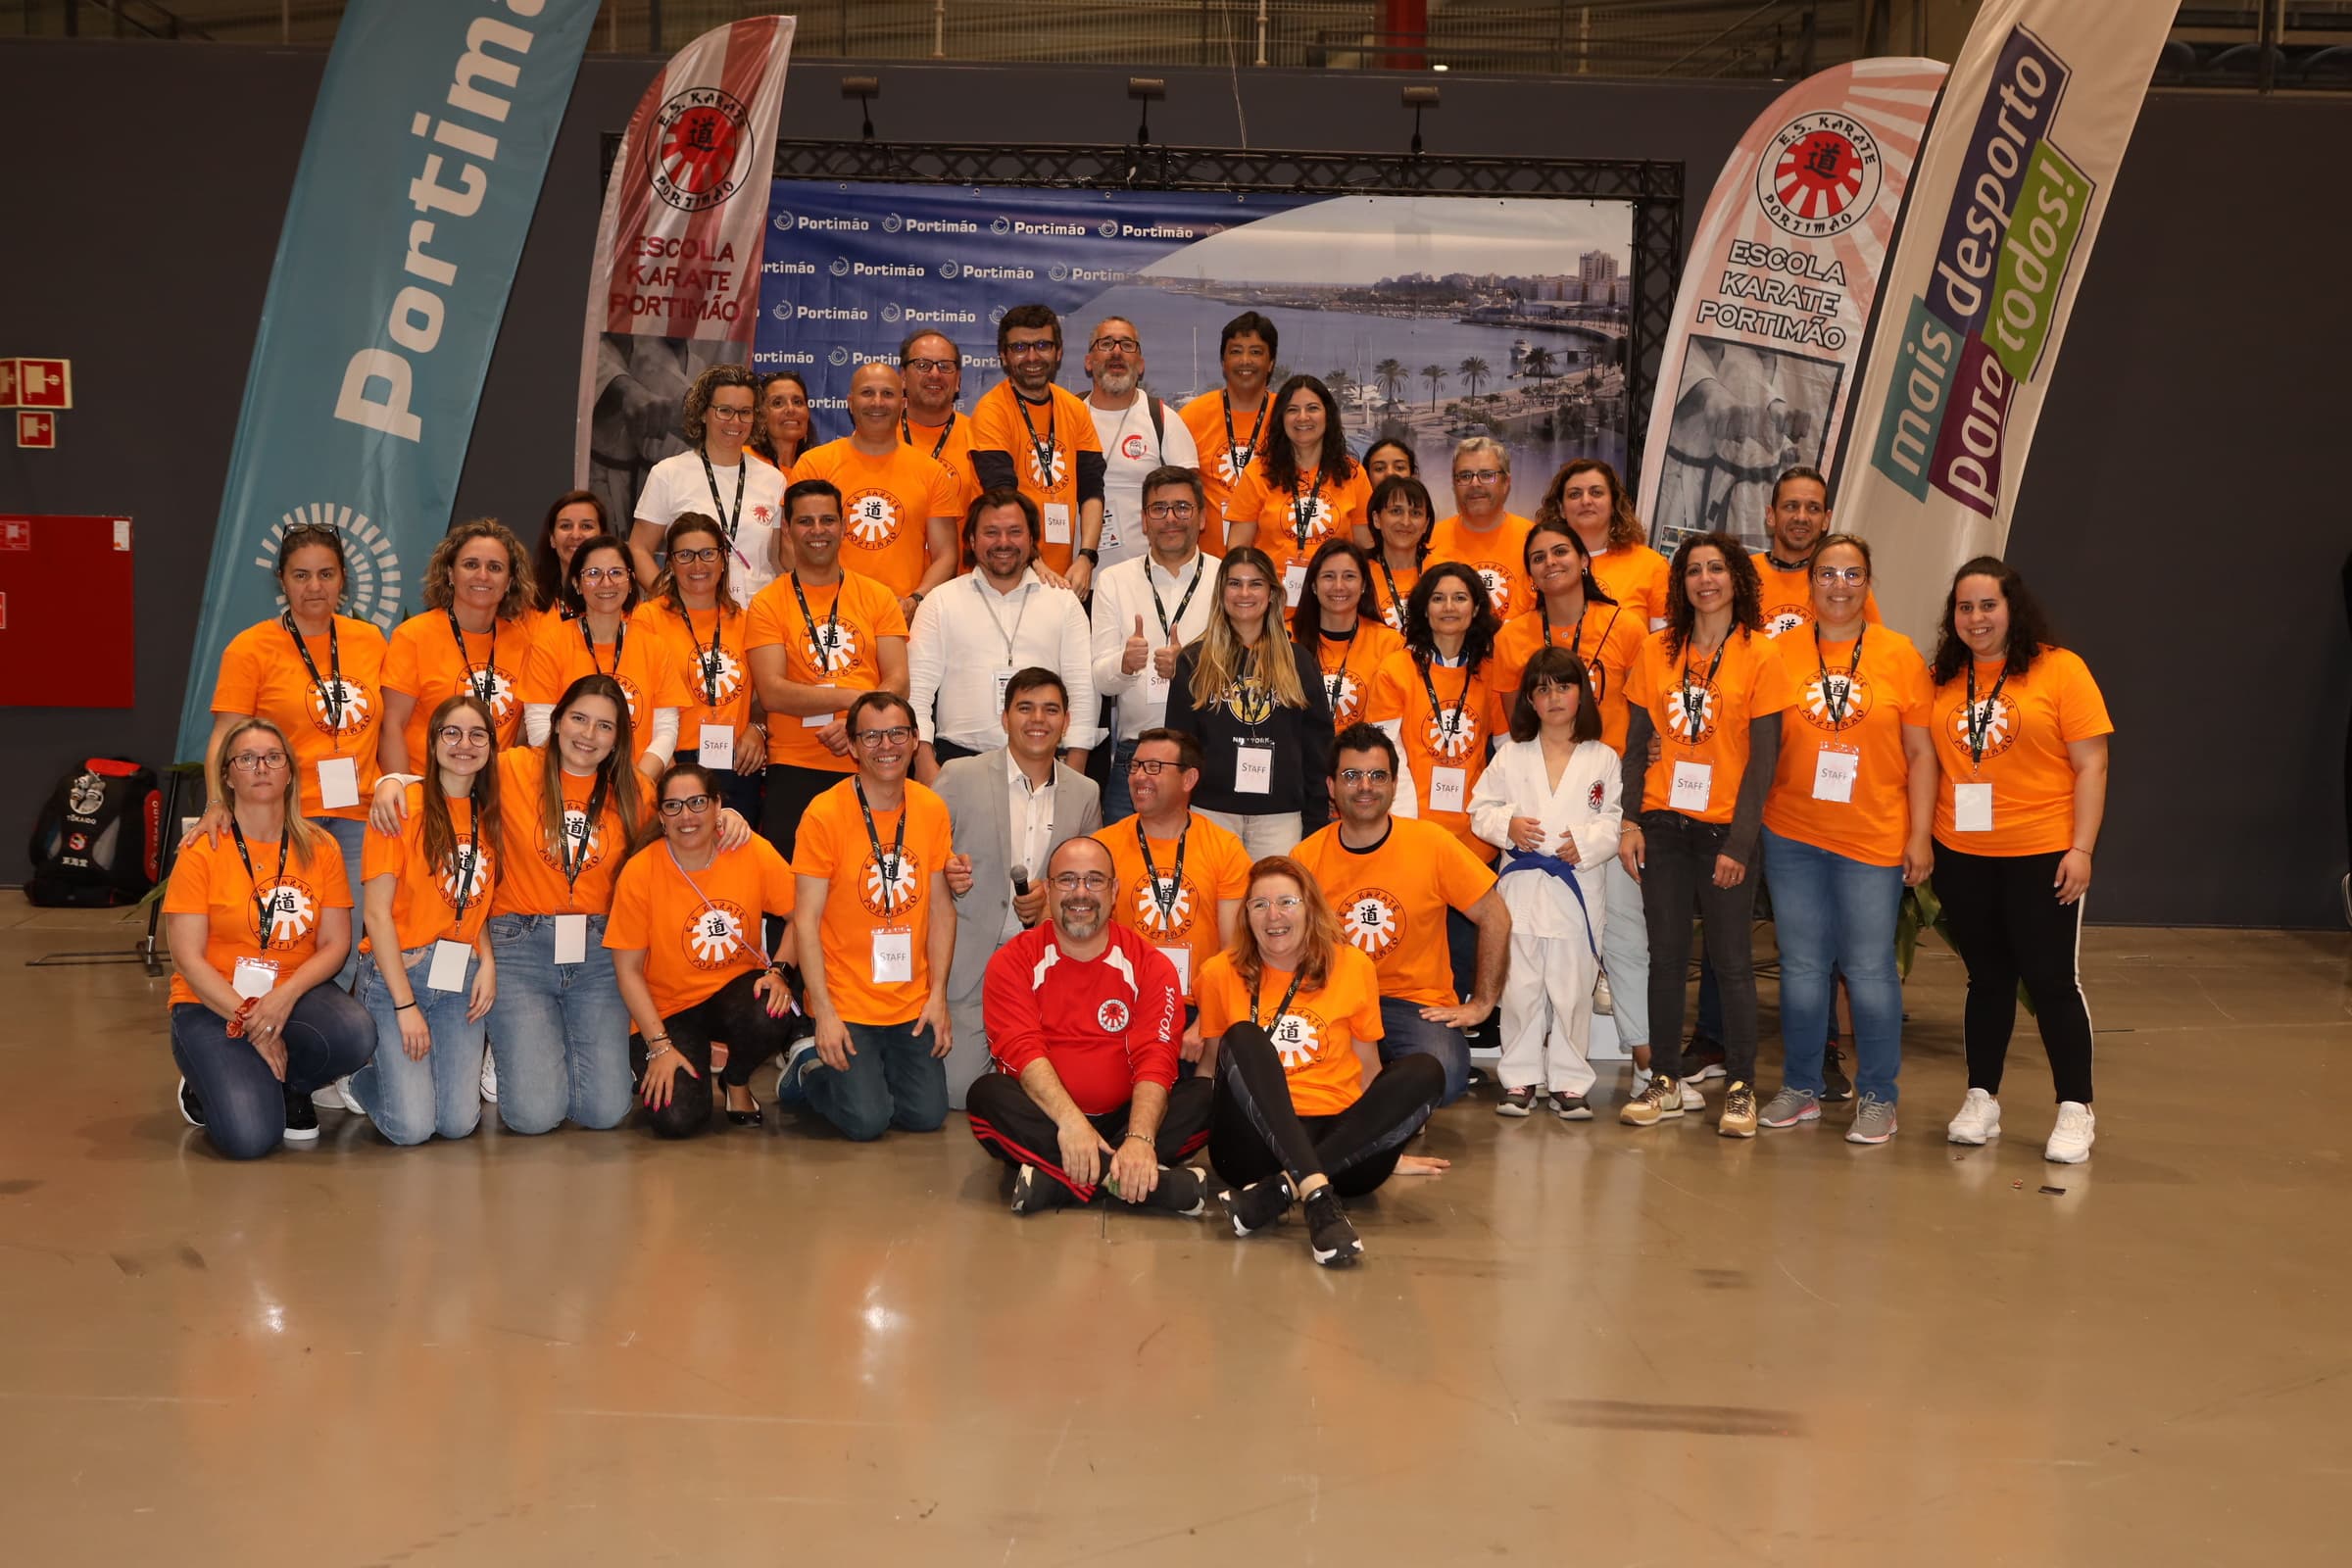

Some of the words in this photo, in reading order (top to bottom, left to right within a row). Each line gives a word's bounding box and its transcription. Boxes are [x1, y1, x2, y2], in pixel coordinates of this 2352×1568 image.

[691, 93, 746, 129] KARATE
[688, 117, 717, 152] 道
[1778, 123, 1812, 146] E.S.
[1819, 117, 1876, 165] KARATE
[1803, 140, 1841, 179] 道
[334, 0, 546, 443] Portim
[1764, 193, 1852, 234] PORTIMÃO
[798, 217, 869, 231] Portimão
[906, 218, 977, 233] Portimão
[1014, 221, 1086, 236] Portimão
[1122, 224, 1194, 239] Portimão
[629, 235, 735, 263] ESCOLA
[1995, 158, 2077, 353] todos!
[760, 260, 815, 274] rtimão
[854, 261, 925, 276] Portimão
[963, 265, 1035, 279] Portimão
[1728, 239, 1846, 287] ESCOLA
[1890, 320, 1953, 477] mais
[1936, 54, 2048, 318] desporto
[626, 264, 731, 291] KARATE
[1719, 270, 1840, 318] KARATE
[609, 294, 741, 321] PORTIMÃO
[797, 306, 868, 320] Portimão
[906, 308, 976, 322] Portimão
[1696, 300, 1846, 351] PORTIMÃO
[752, 351, 814, 364] ortimão
[864, 501, 883, 520] 道
[1048, 517, 1066, 526] STAFF
[704, 739, 729, 751] STAFF
[1242, 761, 1266, 774] STAFF
[1821, 767, 1848, 781] STAFF
[1435, 781, 1459, 793] STAFF
[1678, 777, 1704, 791] STAFF
[274, 892, 299, 914] 道
[1360, 904, 1382, 927] 道
[707, 916, 728, 938] 道
[879, 952, 907, 962] STAFF
[1278, 1020, 1302, 1045] 道
